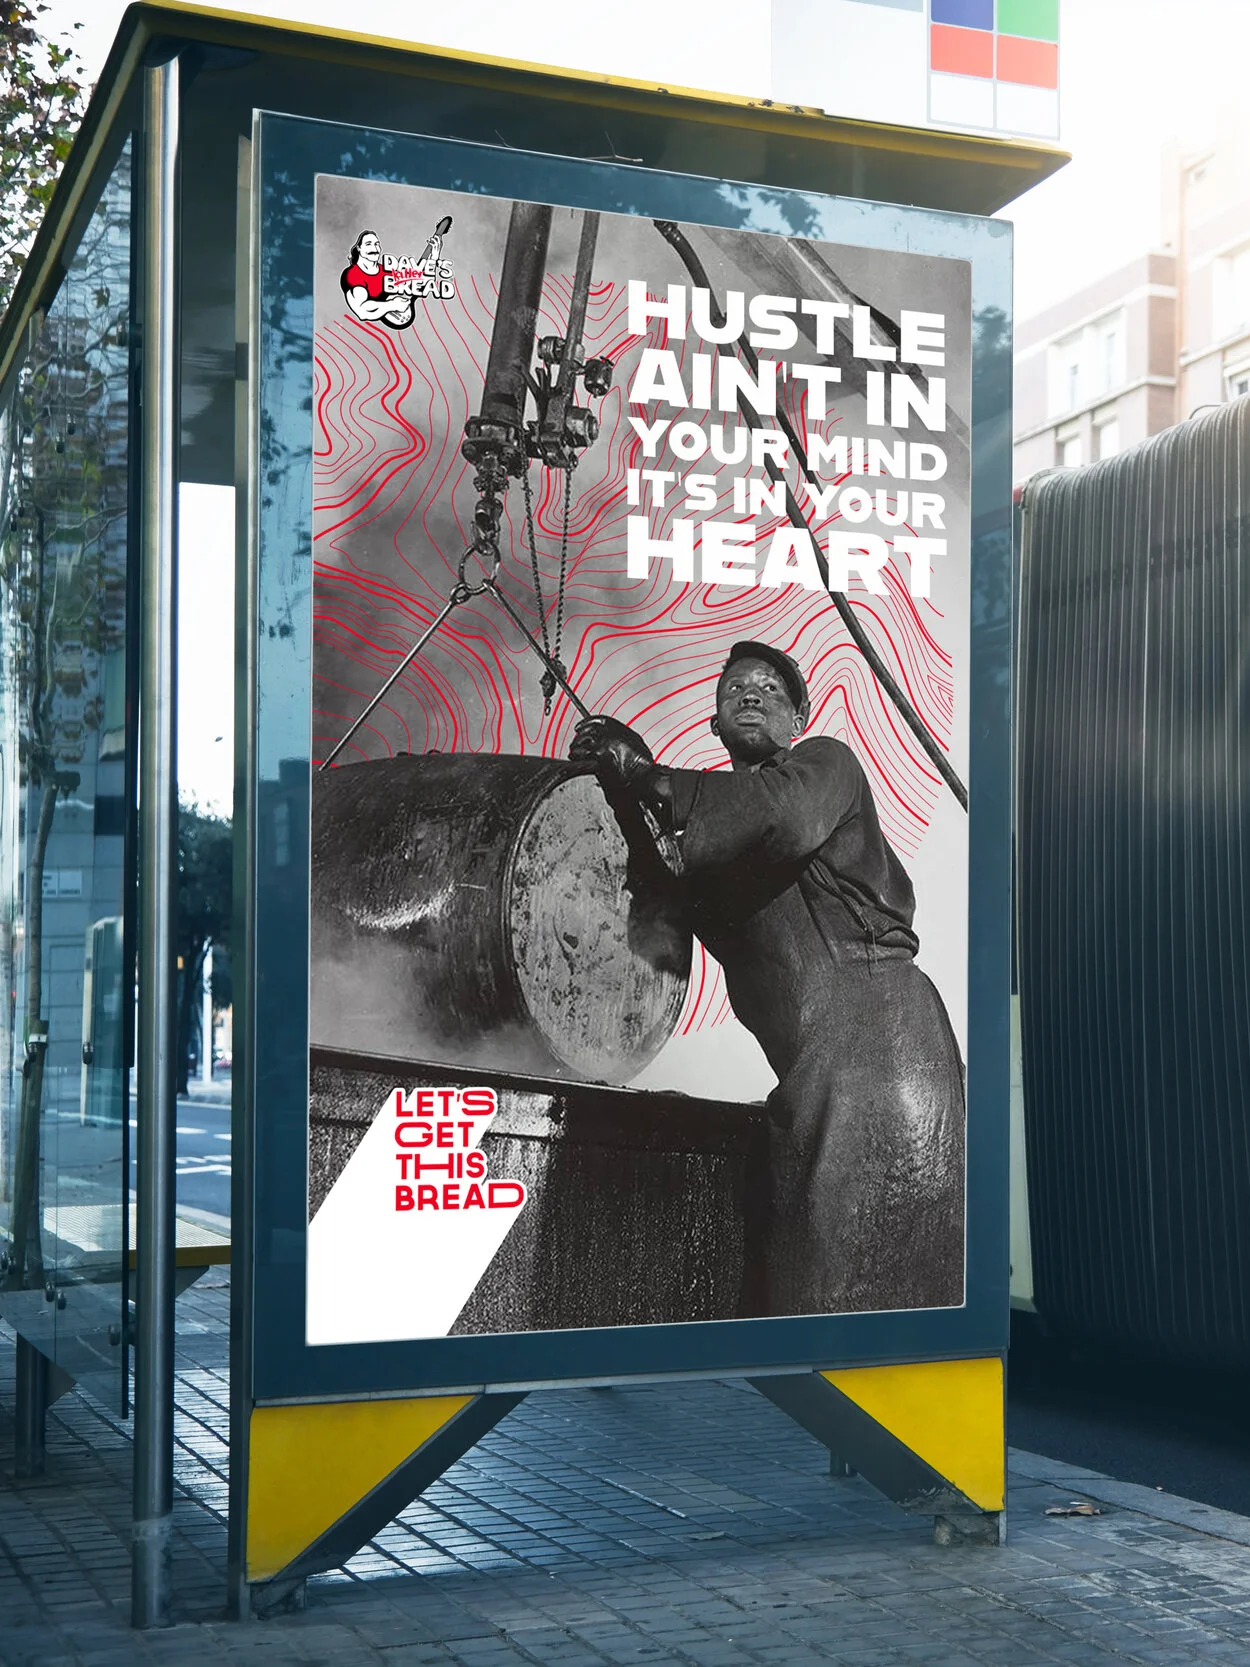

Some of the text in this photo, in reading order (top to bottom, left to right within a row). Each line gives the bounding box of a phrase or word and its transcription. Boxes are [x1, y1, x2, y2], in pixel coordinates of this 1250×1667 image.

[383, 254, 453, 278] DAVE'S
[383, 275, 455, 299] BREAD
[627, 279, 945, 367] HUSTLE
[628, 347, 946, 432] AIN'T IN
[627, 416, 948, 482] YOUR MIND
[627, 468, 946, 530] IT'S IN YOUR
[627, 515, 947, 598] HEART
[396, 1090, 495, 1117] LET'S
[394, 1121, 474, 1147] GET
[395, 1152, 485, 1180] THIS
[395, 1183, 525, 1211] BREAD
